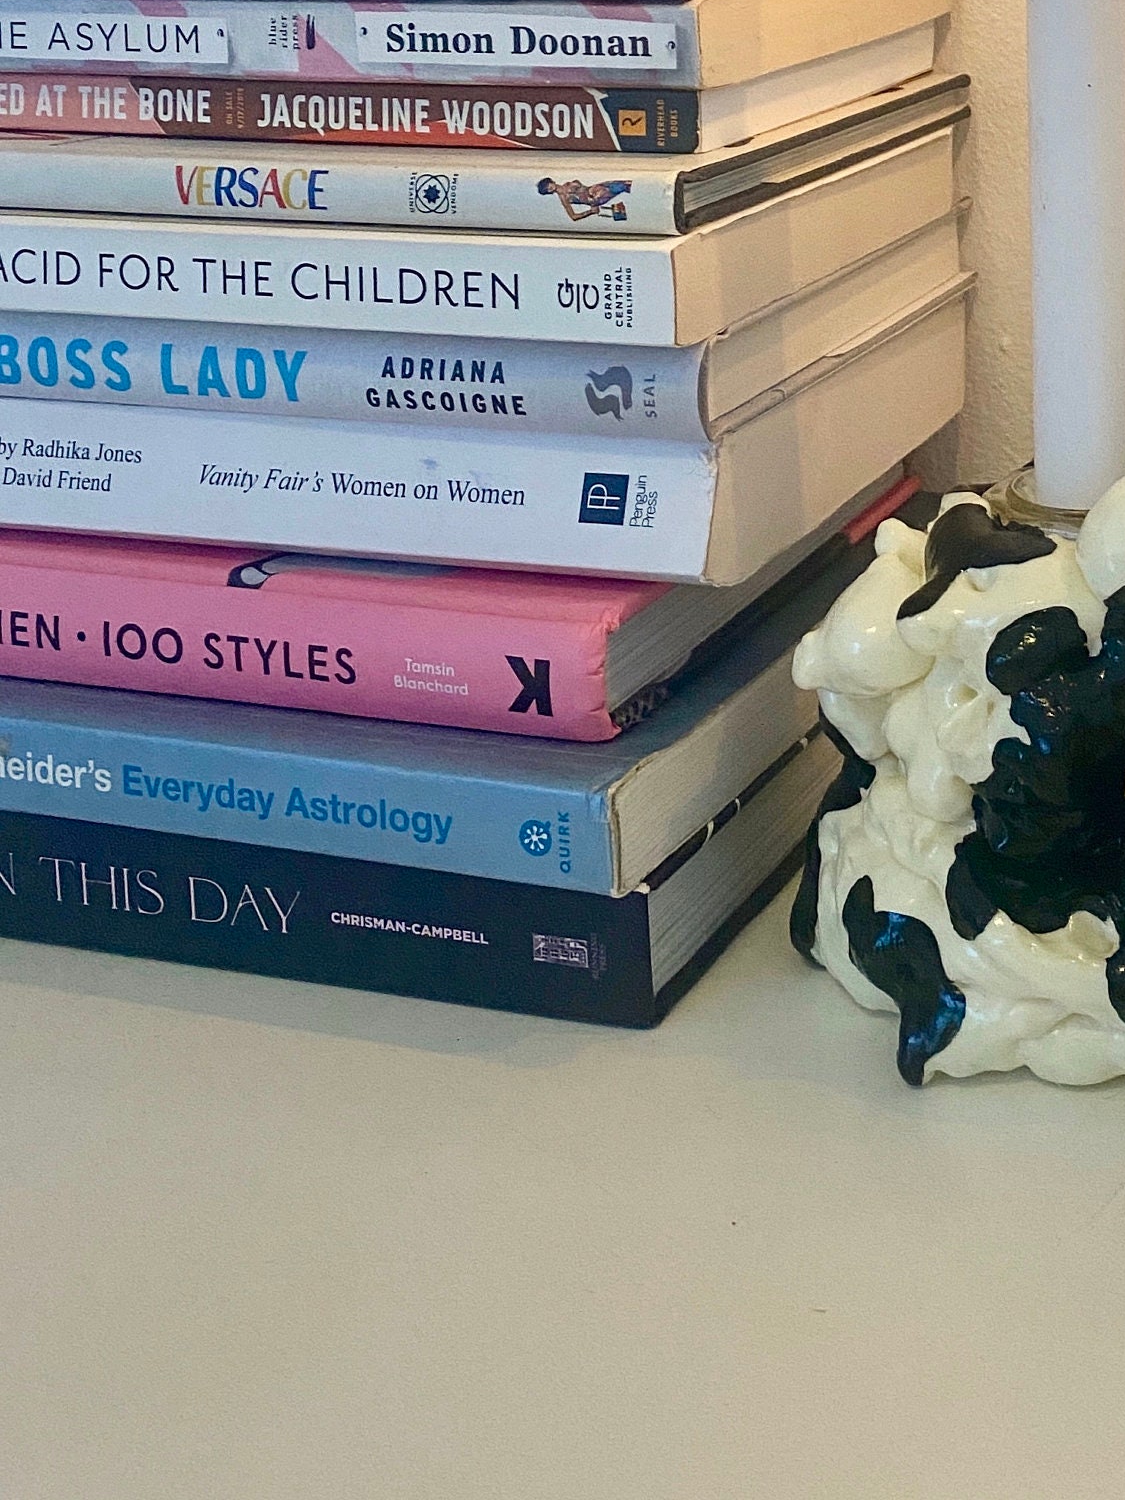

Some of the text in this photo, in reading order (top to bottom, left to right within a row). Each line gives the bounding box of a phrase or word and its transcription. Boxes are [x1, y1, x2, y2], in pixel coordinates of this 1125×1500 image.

[0, 21, 201, 54] E ASYLUM
[268, 17, 277, 46] blue
[279, 15, 289, 49] rider
[292, 14, 301, 50] press
[386, 23, 653, 58] Simon Doonan
[35, 84, 67, 118] AT
[78, 85, 128, 120] THE
[138, 87, 212, 124] BONE
[225, 112, 233, 125] ON
[257, 93, 594, 140] JACQUELINE WOODSON
[655, 99, 666, 147] RIVERHEAD
[669, 108, 680, 138] BOOKS
[175, 165, 329, 211] VERSACE
[408, 171, 418, 213] UNIVERSE
[449, 173, 460, 214] VENDOME
[98, 253, 180, 292] FOR
[192, 257, 274, 297] THE
[291, 262, 521, 310] CHILDREN
[603, 273, 613, 320] GRAND
[614, 266, 624, 328] CENTRAL
[625, 267, 633, 328] PUBLISHING
[160, 343, 308, 403] LADY
[381, 356, 506, 385] ADRIANA
[365, 387, 527, 417] GASCOIGNE
[643, 373, 658, 419] SEAL
[22, 438, 91, 461] Radhika
[94, 442, 143, 465] Jones
[2, 466, 113, 493] David Friend
[198, 463, 526, 507] Vanity Fair's Women on Women
[628, 474, 648, 528] Penguin
[641, 490, 659, 529] Press
[0, 610, 358, 684] EN 100 STYLES
[393, 674, 470, 696] Blanchard
[404, 658, 456, 678] Tamsin
[122, 764, 275, 822] Everyday
[284, 787, 454, 846] Astrology
[557, 810, 572, 875] QUIRK
[38, 856, 166, 916] THIS
[187, 876, 301, 934] DAY
[330, 911, 490, 946] CHRISMAN-CAMPBELL
